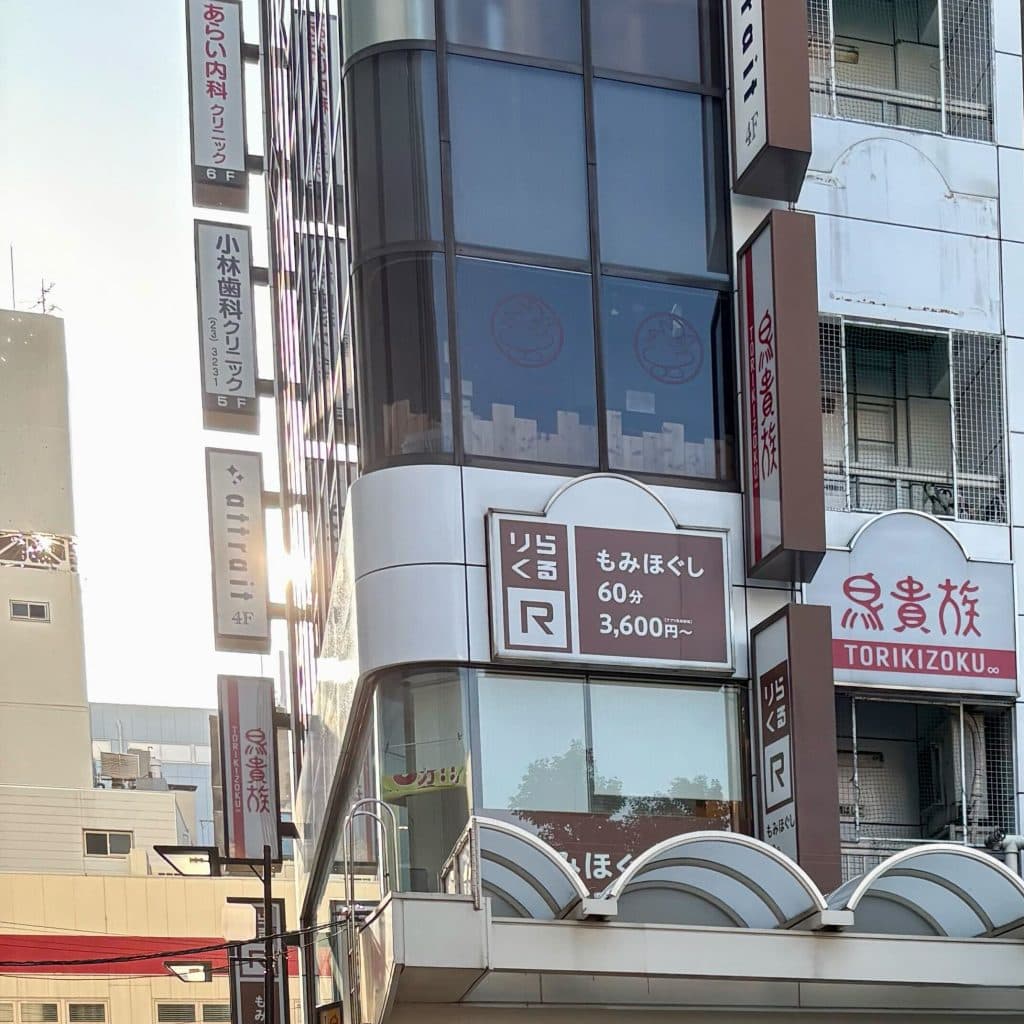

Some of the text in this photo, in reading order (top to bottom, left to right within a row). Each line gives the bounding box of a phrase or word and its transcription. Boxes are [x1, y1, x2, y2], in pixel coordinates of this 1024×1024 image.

[215, 234, 243, 392] 小林歯科クリニック
[225, 493, 255, 601] attrait
[510, 532, 556, 555] りら
[511, 558, 557, 581] くる
[596, 549, 705, 578] もみほぐし
[597, 581, 643, 605] 60分
[840, 572, 982, 637] 鳥貴族
[231, 611, 254, 625] 4F
[843, 643, 986, 674] TORIKIZOKU
[231, 725, 242, 808] TORIKIZOKU
[245, 727, 270, 813] 鳥貴族
[765, 813, 796, 839] もみほぐし
